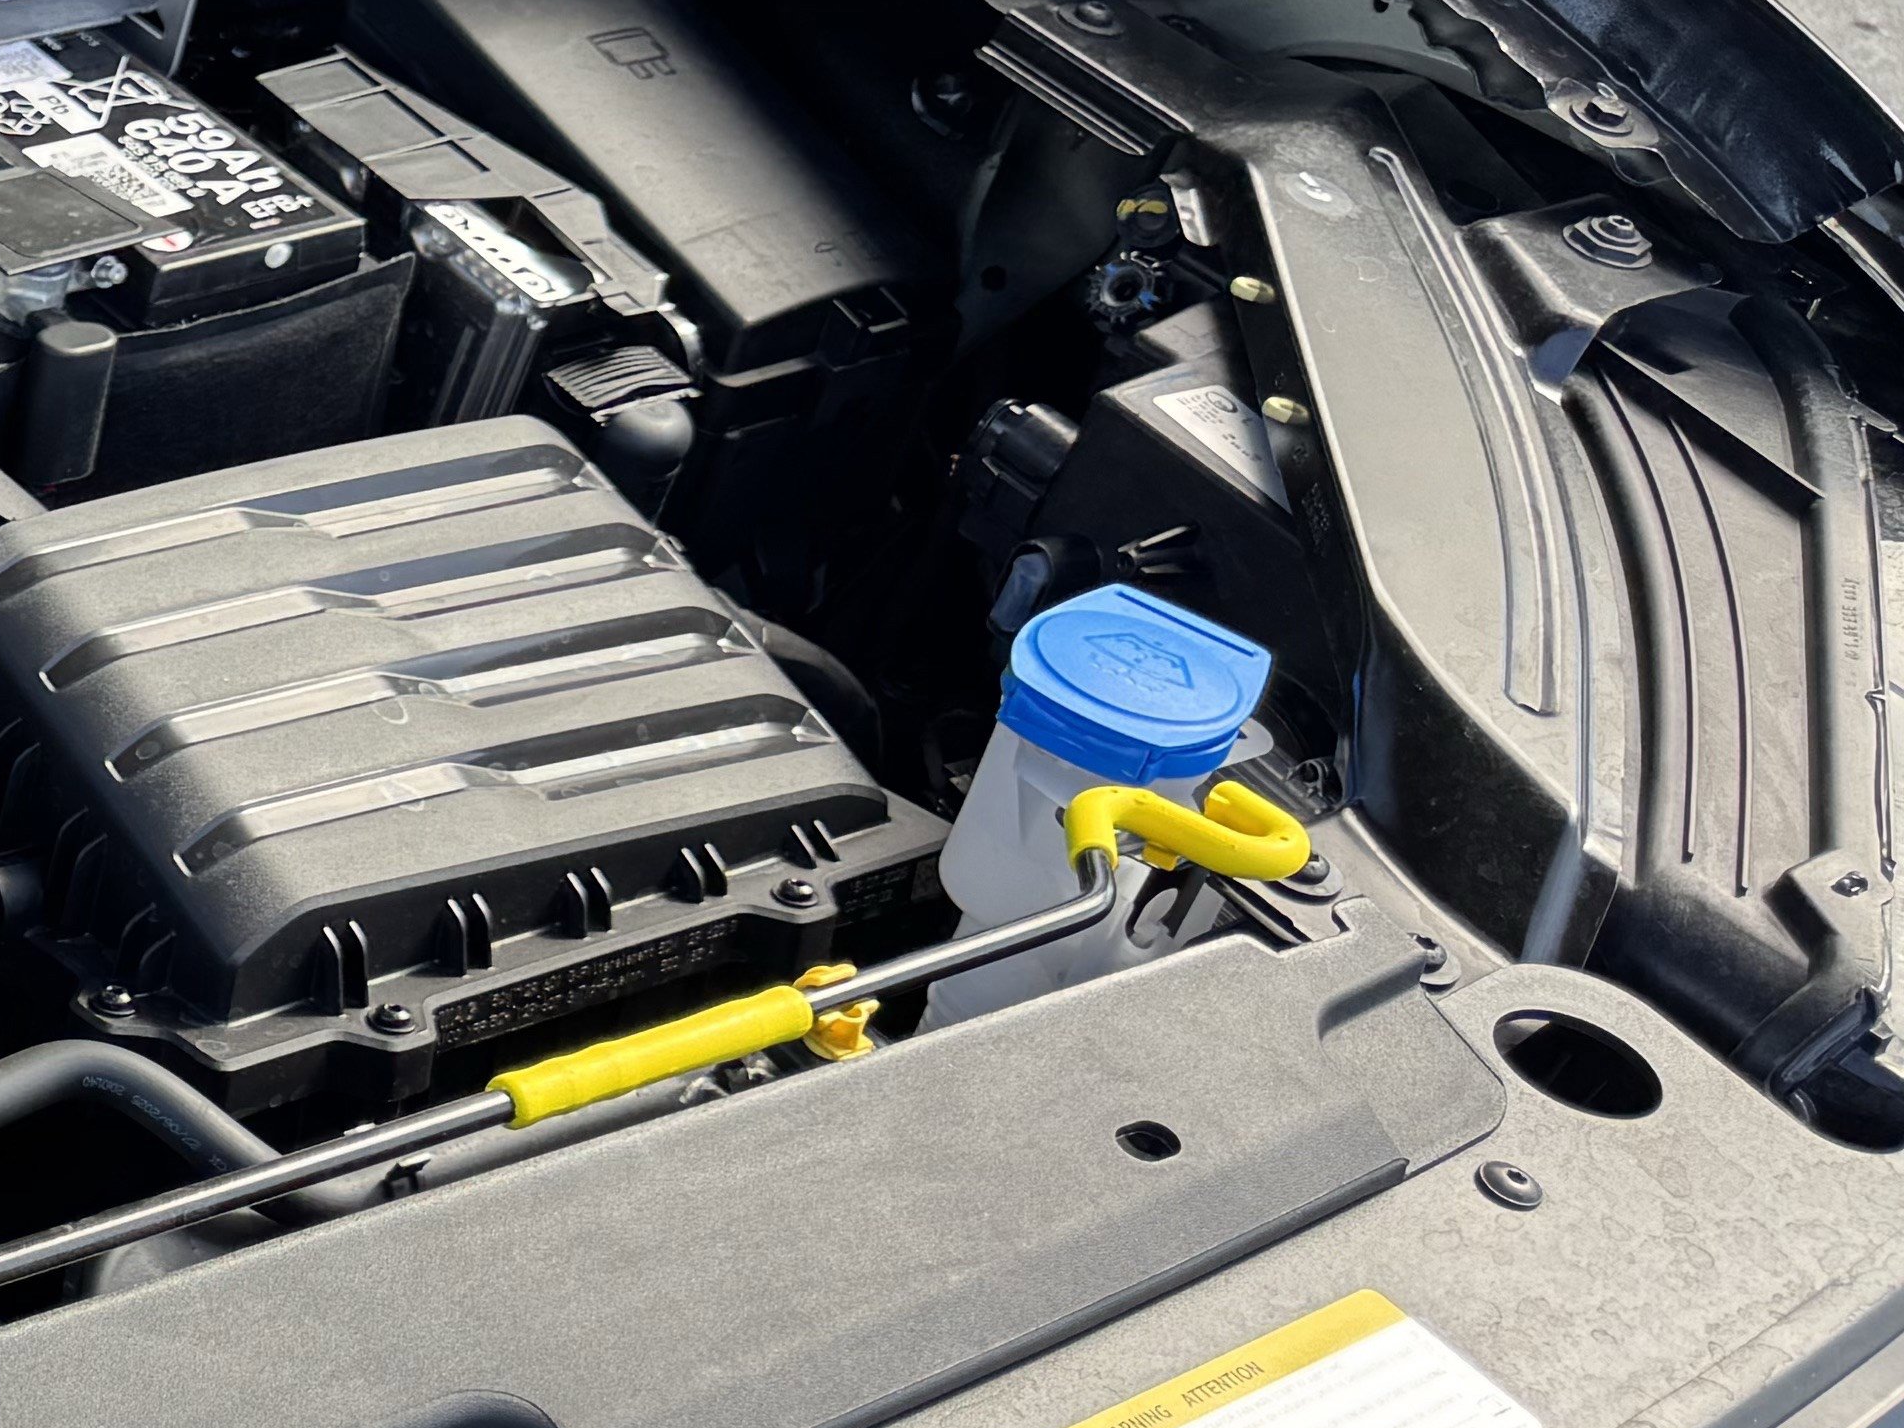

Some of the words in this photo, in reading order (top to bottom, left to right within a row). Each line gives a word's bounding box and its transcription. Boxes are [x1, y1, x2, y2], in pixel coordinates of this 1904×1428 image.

[38, 93, 70, 117] Pb
[124, 118, 210, 174] 640
[163, 112, 284, 193] 59Ah
[241, 193, 315, 221] EFB+
[1181, 1361, 1265, 1407] ATTENTION
